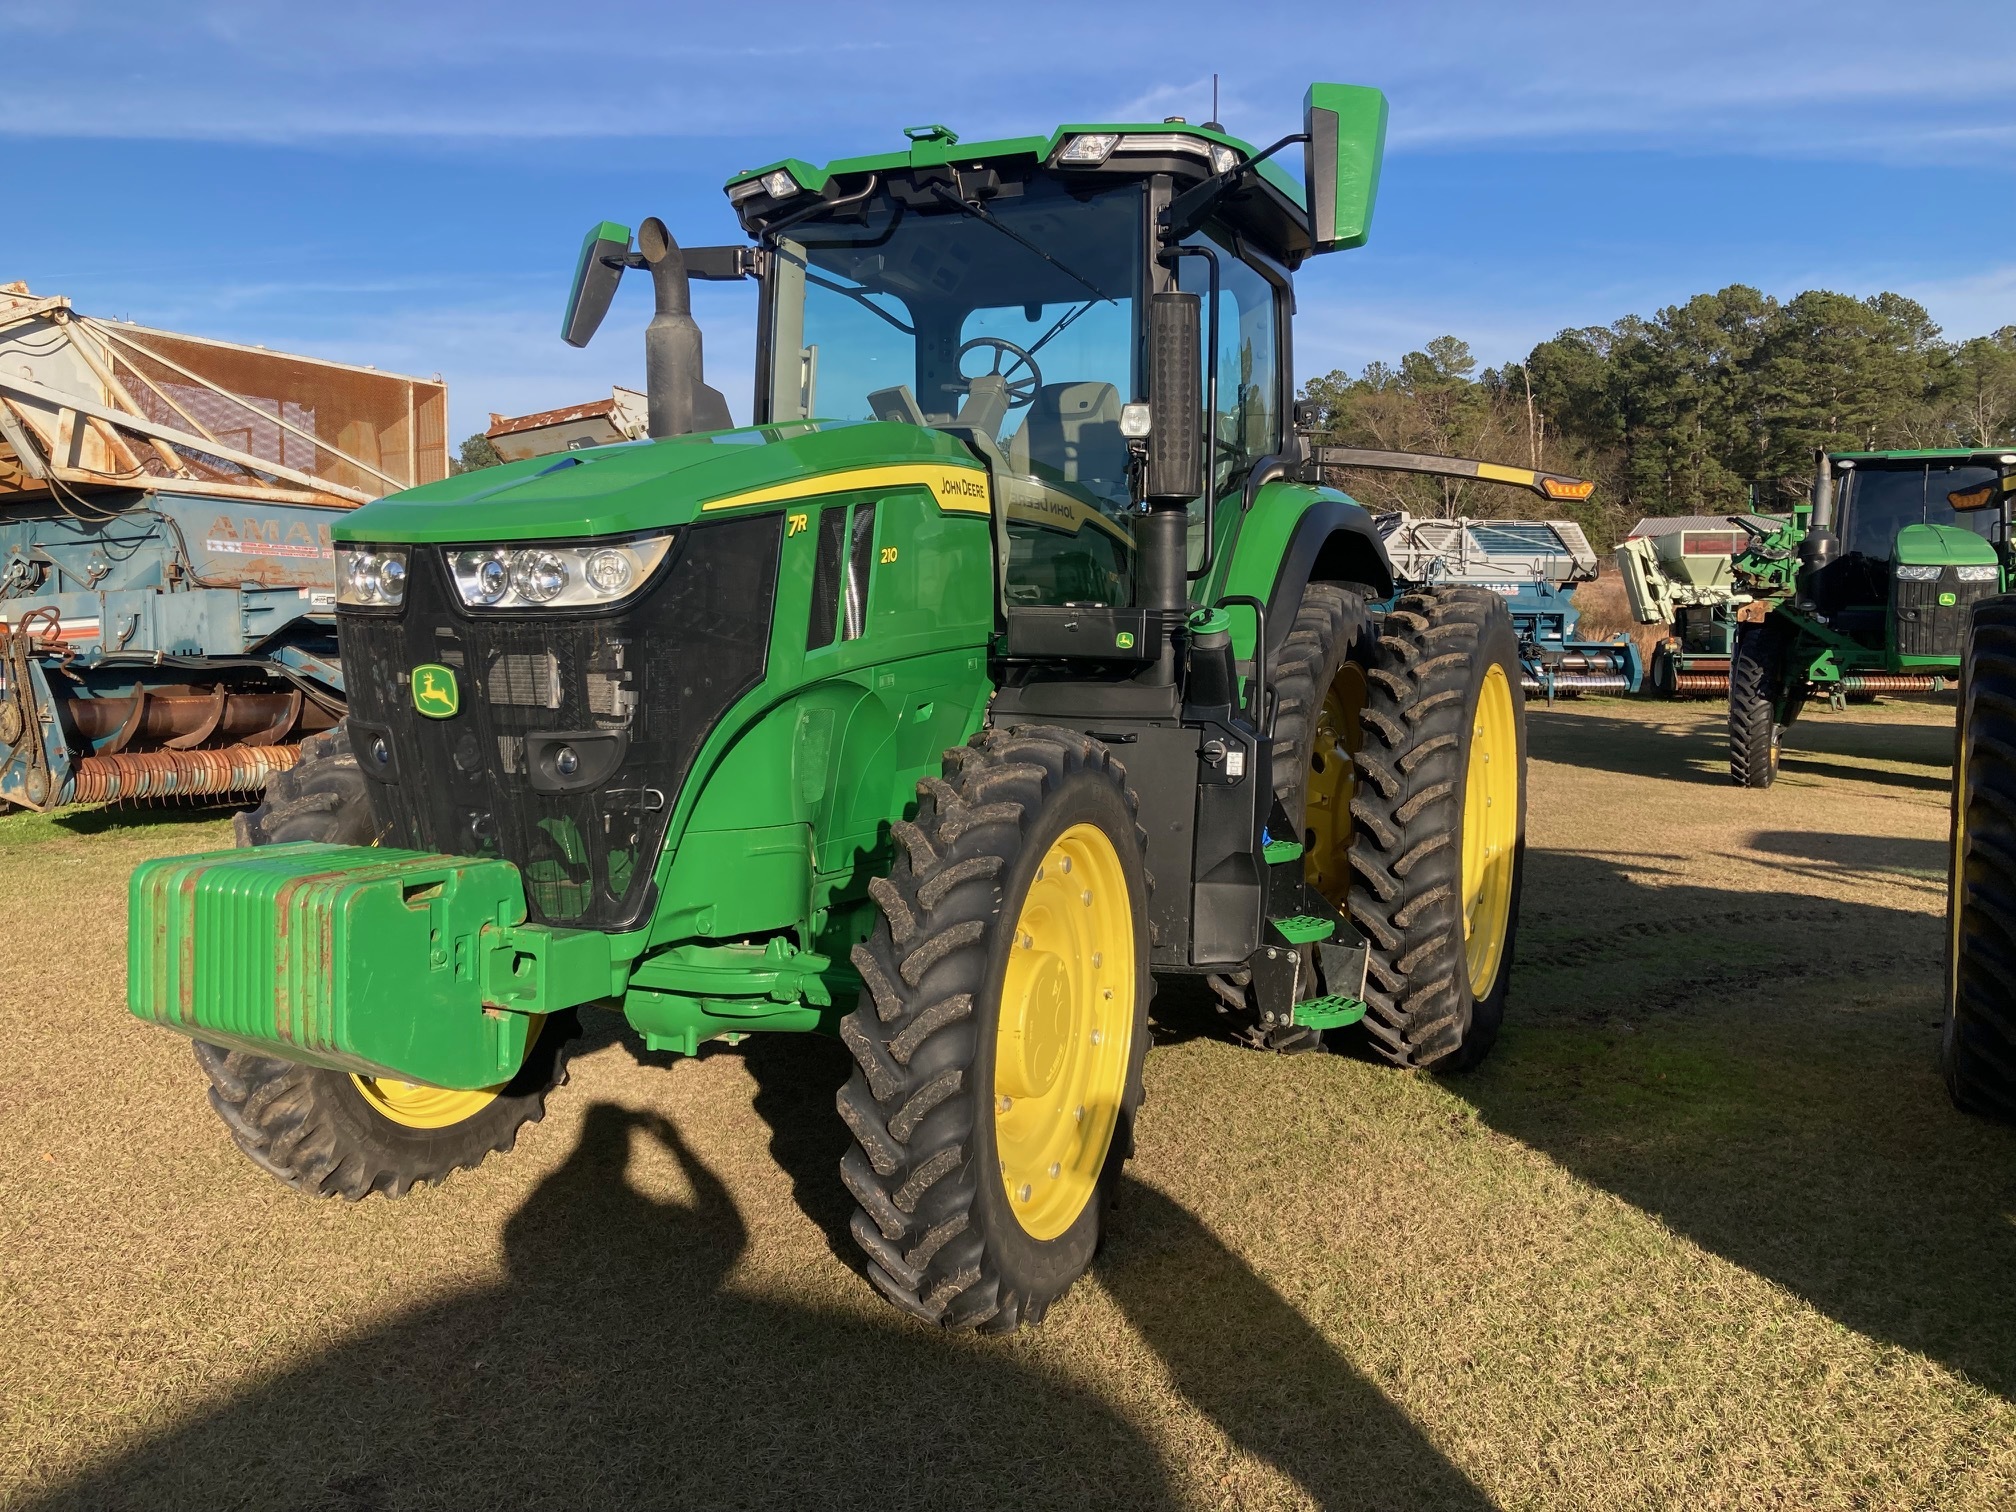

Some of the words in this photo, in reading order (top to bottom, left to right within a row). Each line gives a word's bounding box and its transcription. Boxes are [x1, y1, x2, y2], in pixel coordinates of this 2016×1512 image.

[941, 477, 962, 496] JOHN
[962, 479, 985, 499] DEERE
[788, 514, 808, 538] 7R
[880, 547, 898, 564] 210
